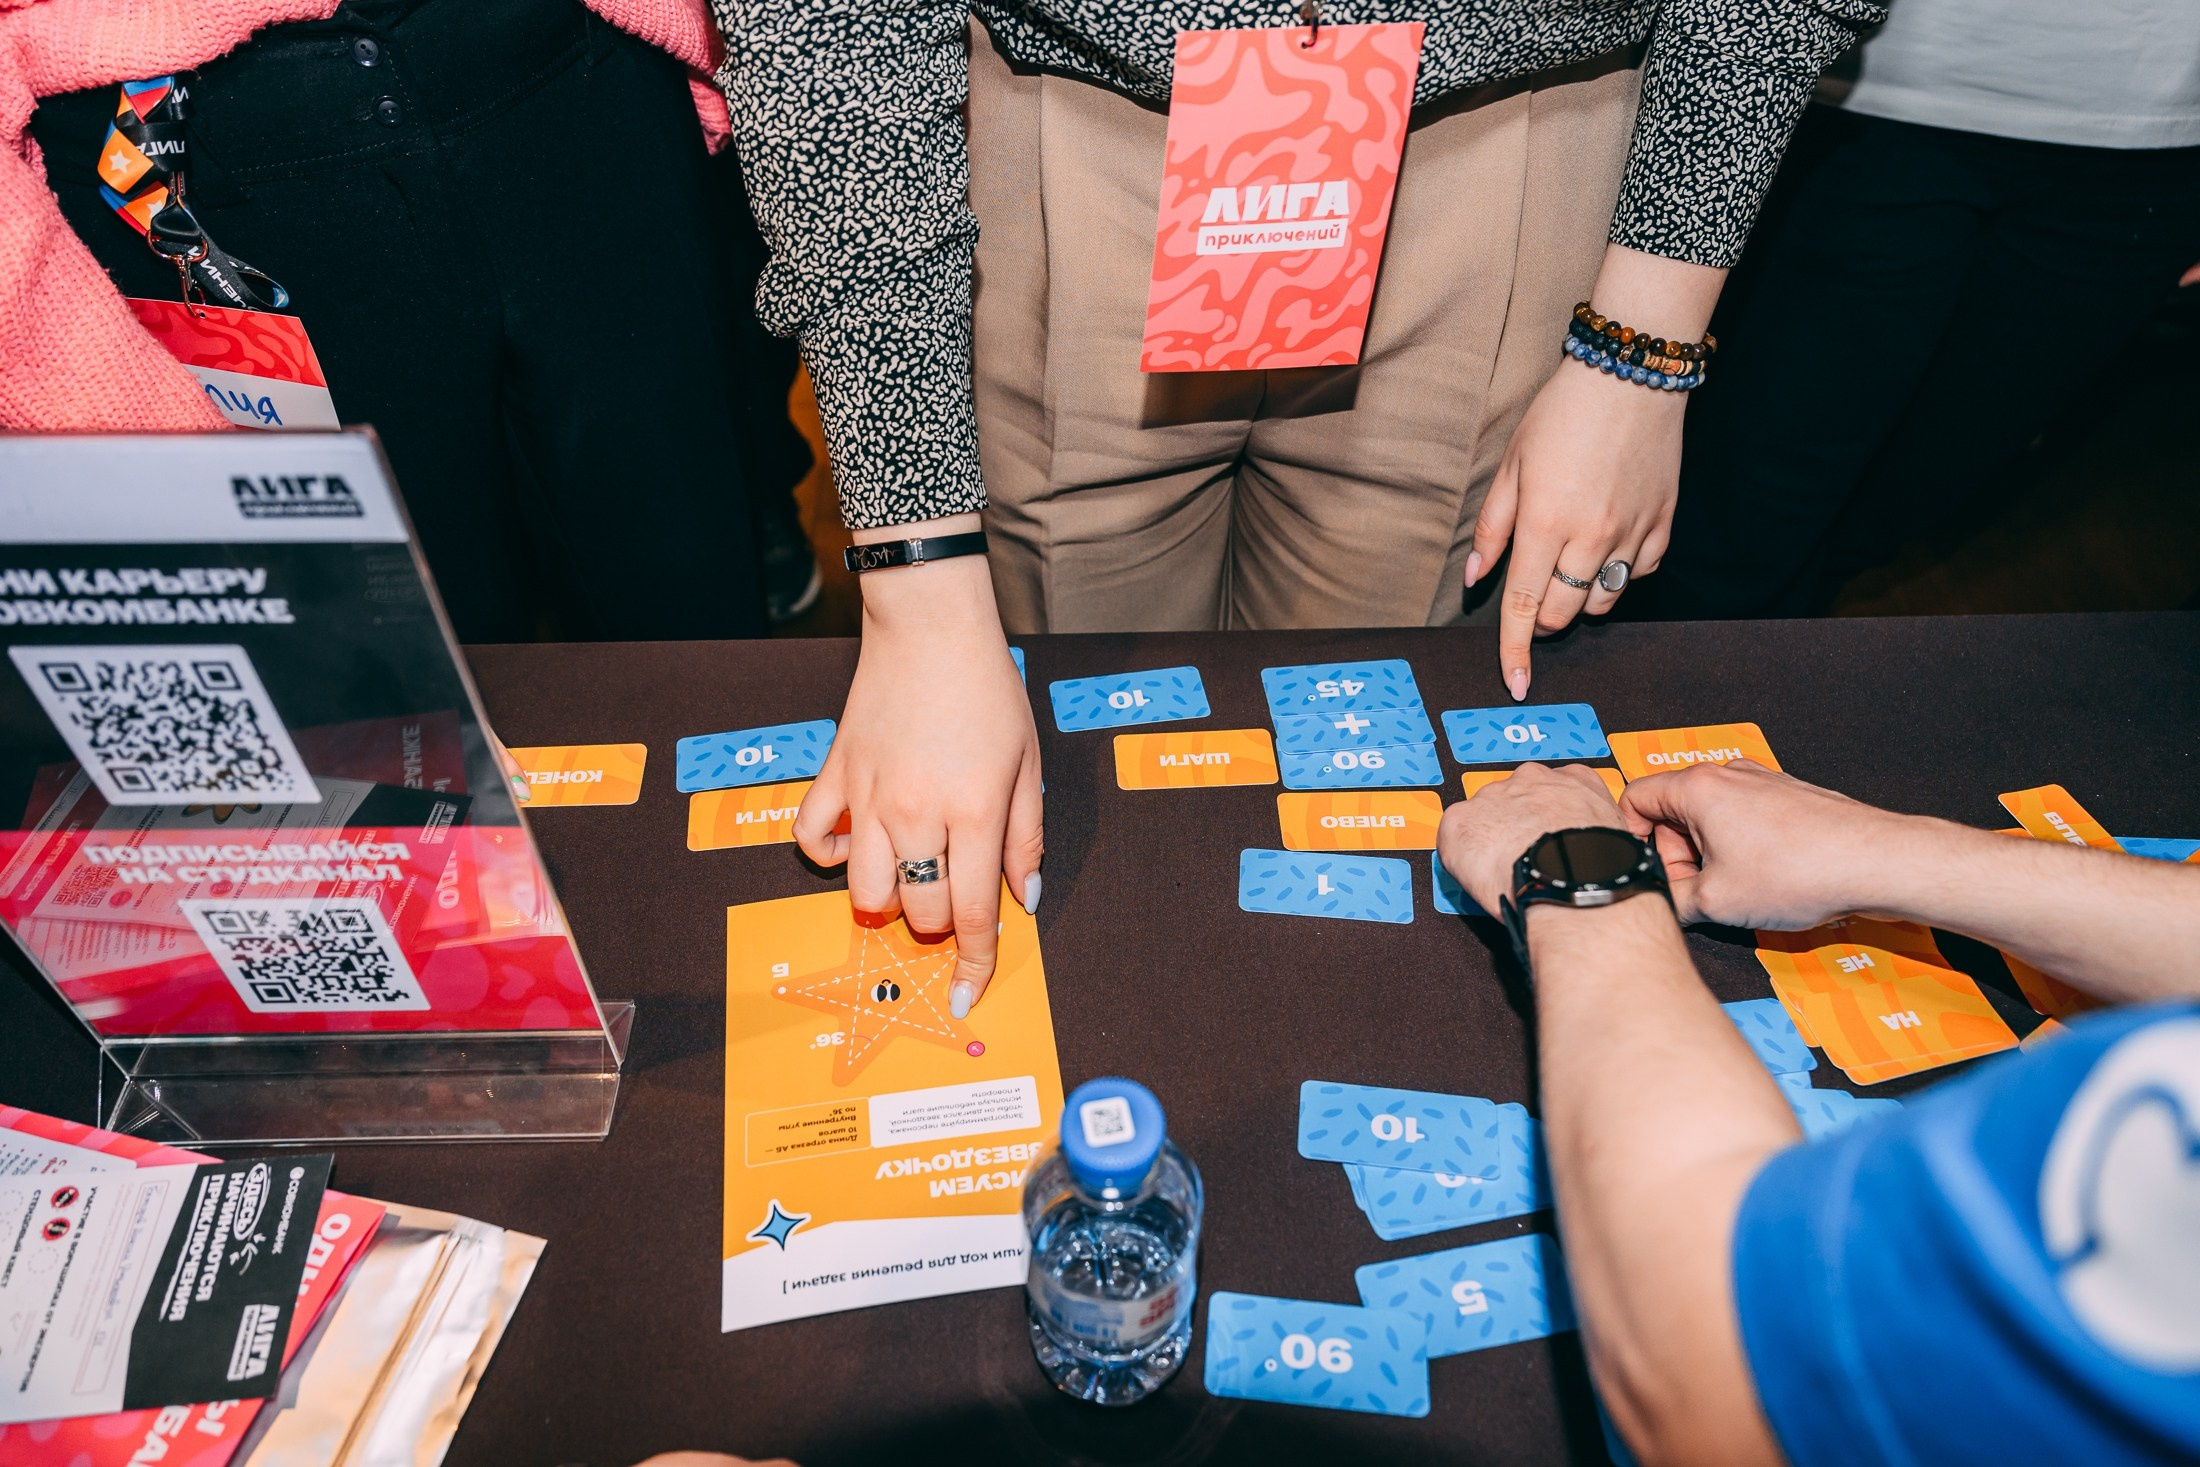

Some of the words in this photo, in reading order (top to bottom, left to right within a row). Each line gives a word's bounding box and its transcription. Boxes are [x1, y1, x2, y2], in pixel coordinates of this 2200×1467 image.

[1200, 180, 1350, 223] ЛИГА
[1205, 224, 1340, 249] приключений
[231, 474, 353, 496] ЛИГА
[58, 568, 267, 594] КАРЬЕРУ
[1108, 689, 1150, 709] 10
[1503, 724, 1548, 743] 10
[734, 744, 779, 767] 10
[1159, 752, 1231, 767] ШАГИ
[1646, 747, 1743, 766] НАЧАЛО
[1320, 815, 1406, 829] ВЛЕВО
[84, 839, 410, 865] ПОДПИСЫВАЙСЯ
[119, 866, 174, 885] НА
[178, 863, 404, 885] СТУДКАНАЛ
[1317, 874, 1335, 896] 1
[1835, 953, 1875, 973] НЕ
[1878, 1011, 1922, 1030] НА
[779, 1122, 800, 1131] углы
[802, 1115, 857, 1127] Внутренние
[1371, 1113, 1425, 1143] 10
[818, 1128, 846, 1136] шагов
[828, 1134, 858, 1143] Длина
[791, 1139, 826, 1150] отрезка
[239, 1169, 264, 1233] ЗДЕСЬ
[195, 1172, 246, 1302] НАЧИНАЮТСЯ
[169, 1173, 226, 1322] ПРИКЛЮЧЕНИЯ
[961, 1252, 988, 1263] код
[852, 1259, 923, 1281] решения
[929, 1256, 956, 1269] для
[792, 1272, 846, 1290] задачи
[1451, 1280, 1489, 1315] 5
